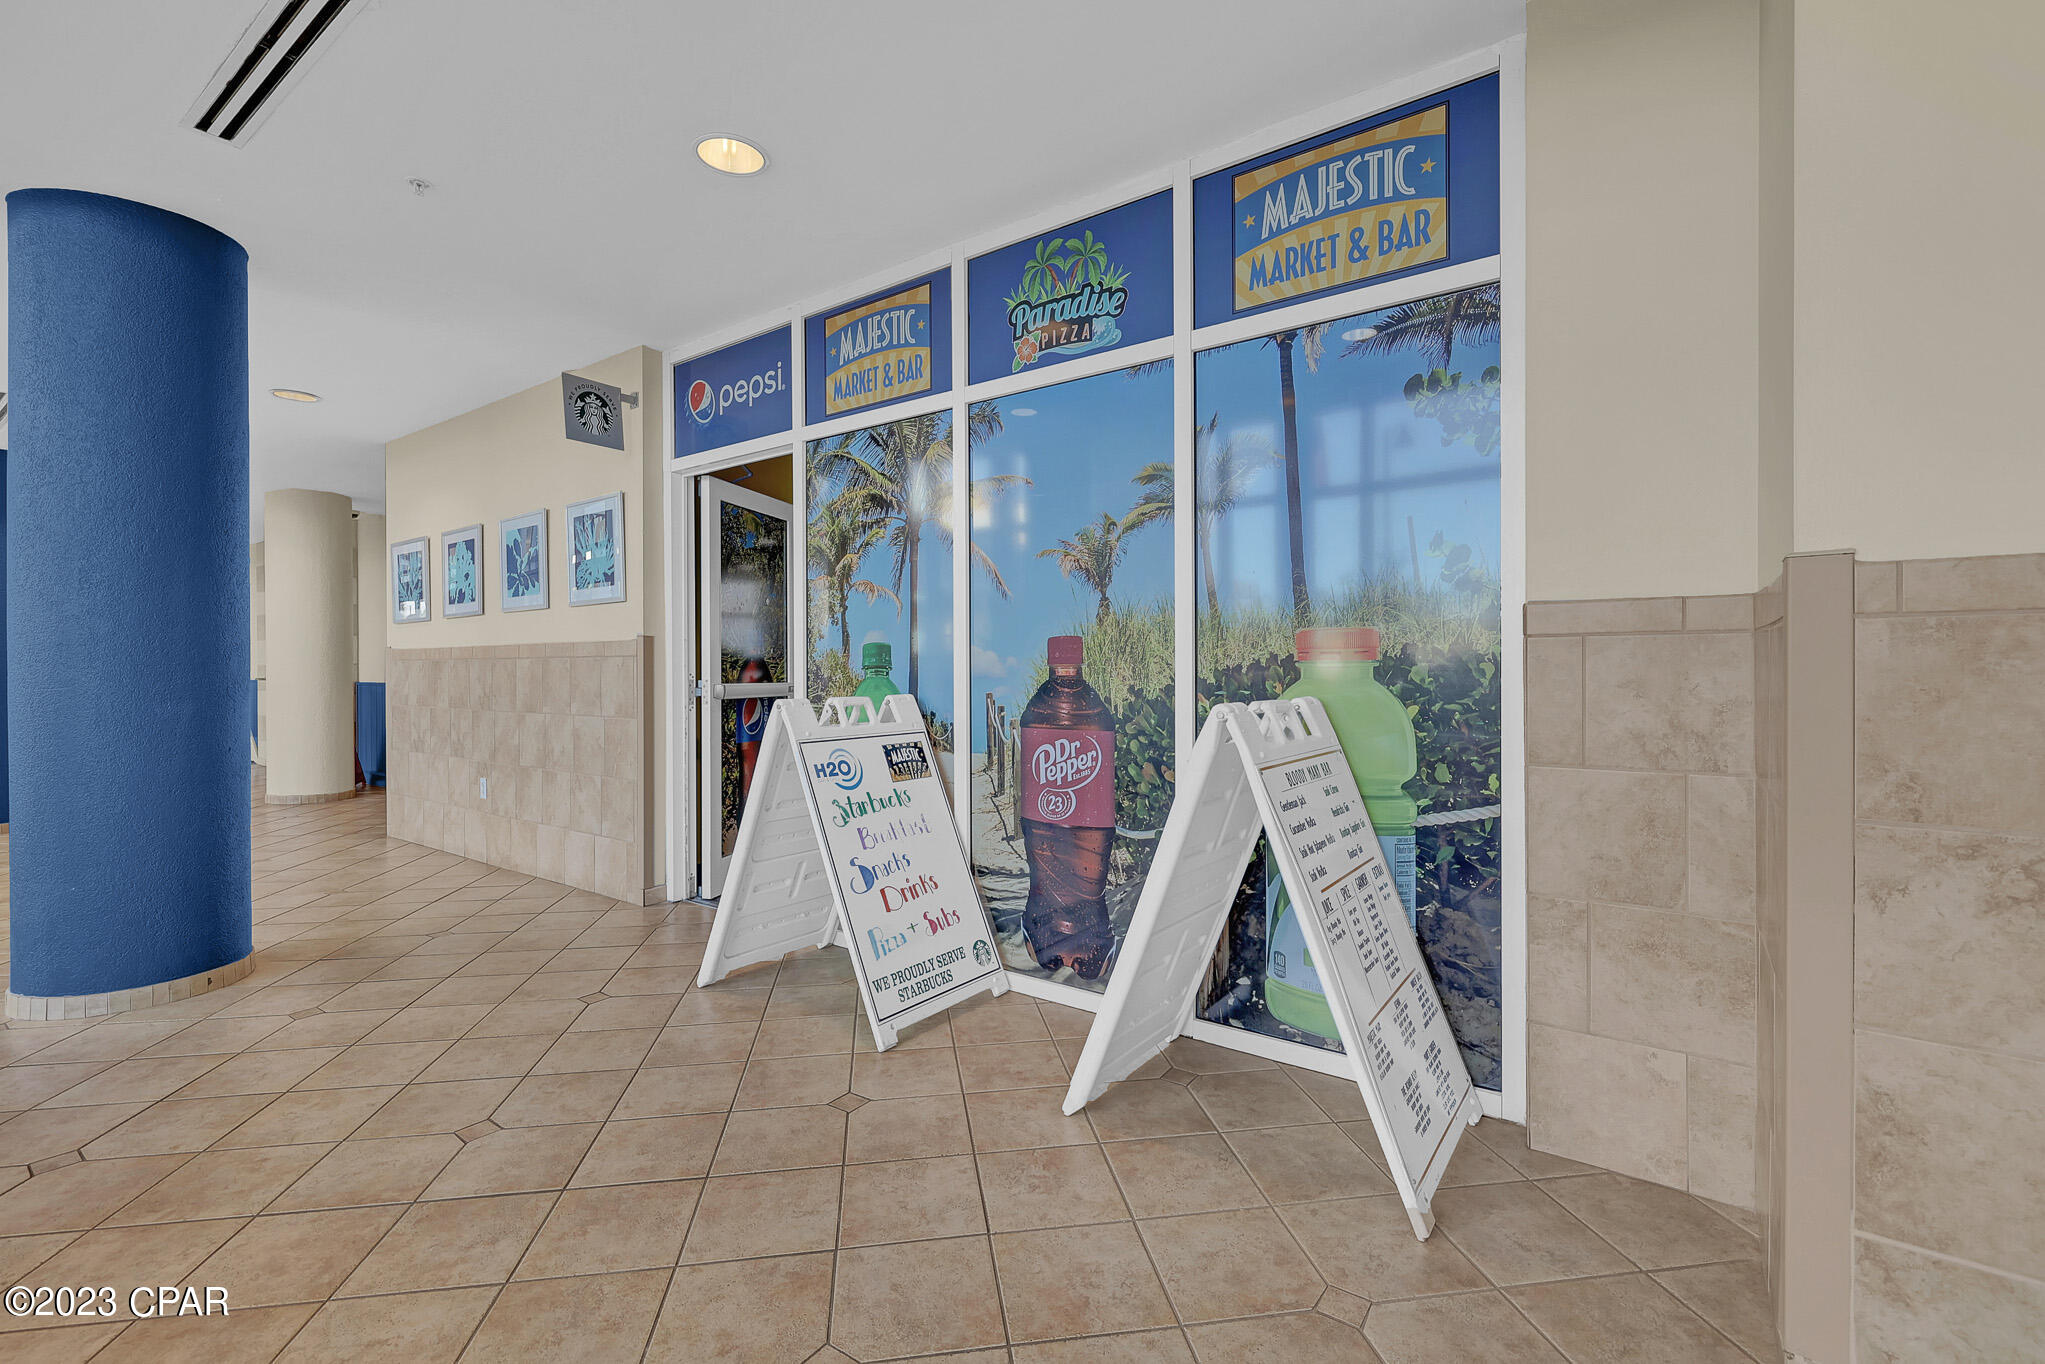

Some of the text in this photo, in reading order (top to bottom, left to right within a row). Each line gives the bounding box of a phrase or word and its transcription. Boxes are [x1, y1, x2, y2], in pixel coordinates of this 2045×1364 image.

[1261, 144, 1416, 241] MAJESTIC
[1249, 208, 1431, 291] MARKET & BAR
[1011, 284, 1126, 337] Paradise
[838, 308, 915, 366] MAJESTIC
[1041, 322, 1090, 348] PIZZA
[575, 383, 601, 392] PROUDLY
[603, 391, 618, 411] SERVE
[719, 361, 784, 415] pepsi
[833, 353, 924, 401] MARKET & BAR
[813, 760, 852, 779] H2O
[890, 747, 922, 764] MAJESTIC
[1035, 743, 1097, 786] Pepper
[1054, 738, 1081, 764] Dr
[1285, 768, 1307, 786] BLOODY
[1320, 762, 1332, 775] BAR
[832, 788, 911, 828] Starbucks
[1048, 795, 1063, 812] 23
[849, 852, 911, 894] Snacks
[880, 874, 939, 912] Drinks
[867, 926, 907, 961] Pizza
[923, 907, 961, 936] Subs
[872, 946, 966, 994] WE PROUDLY SERVE
[898, 969, 954, 1003] STARBUCKS
